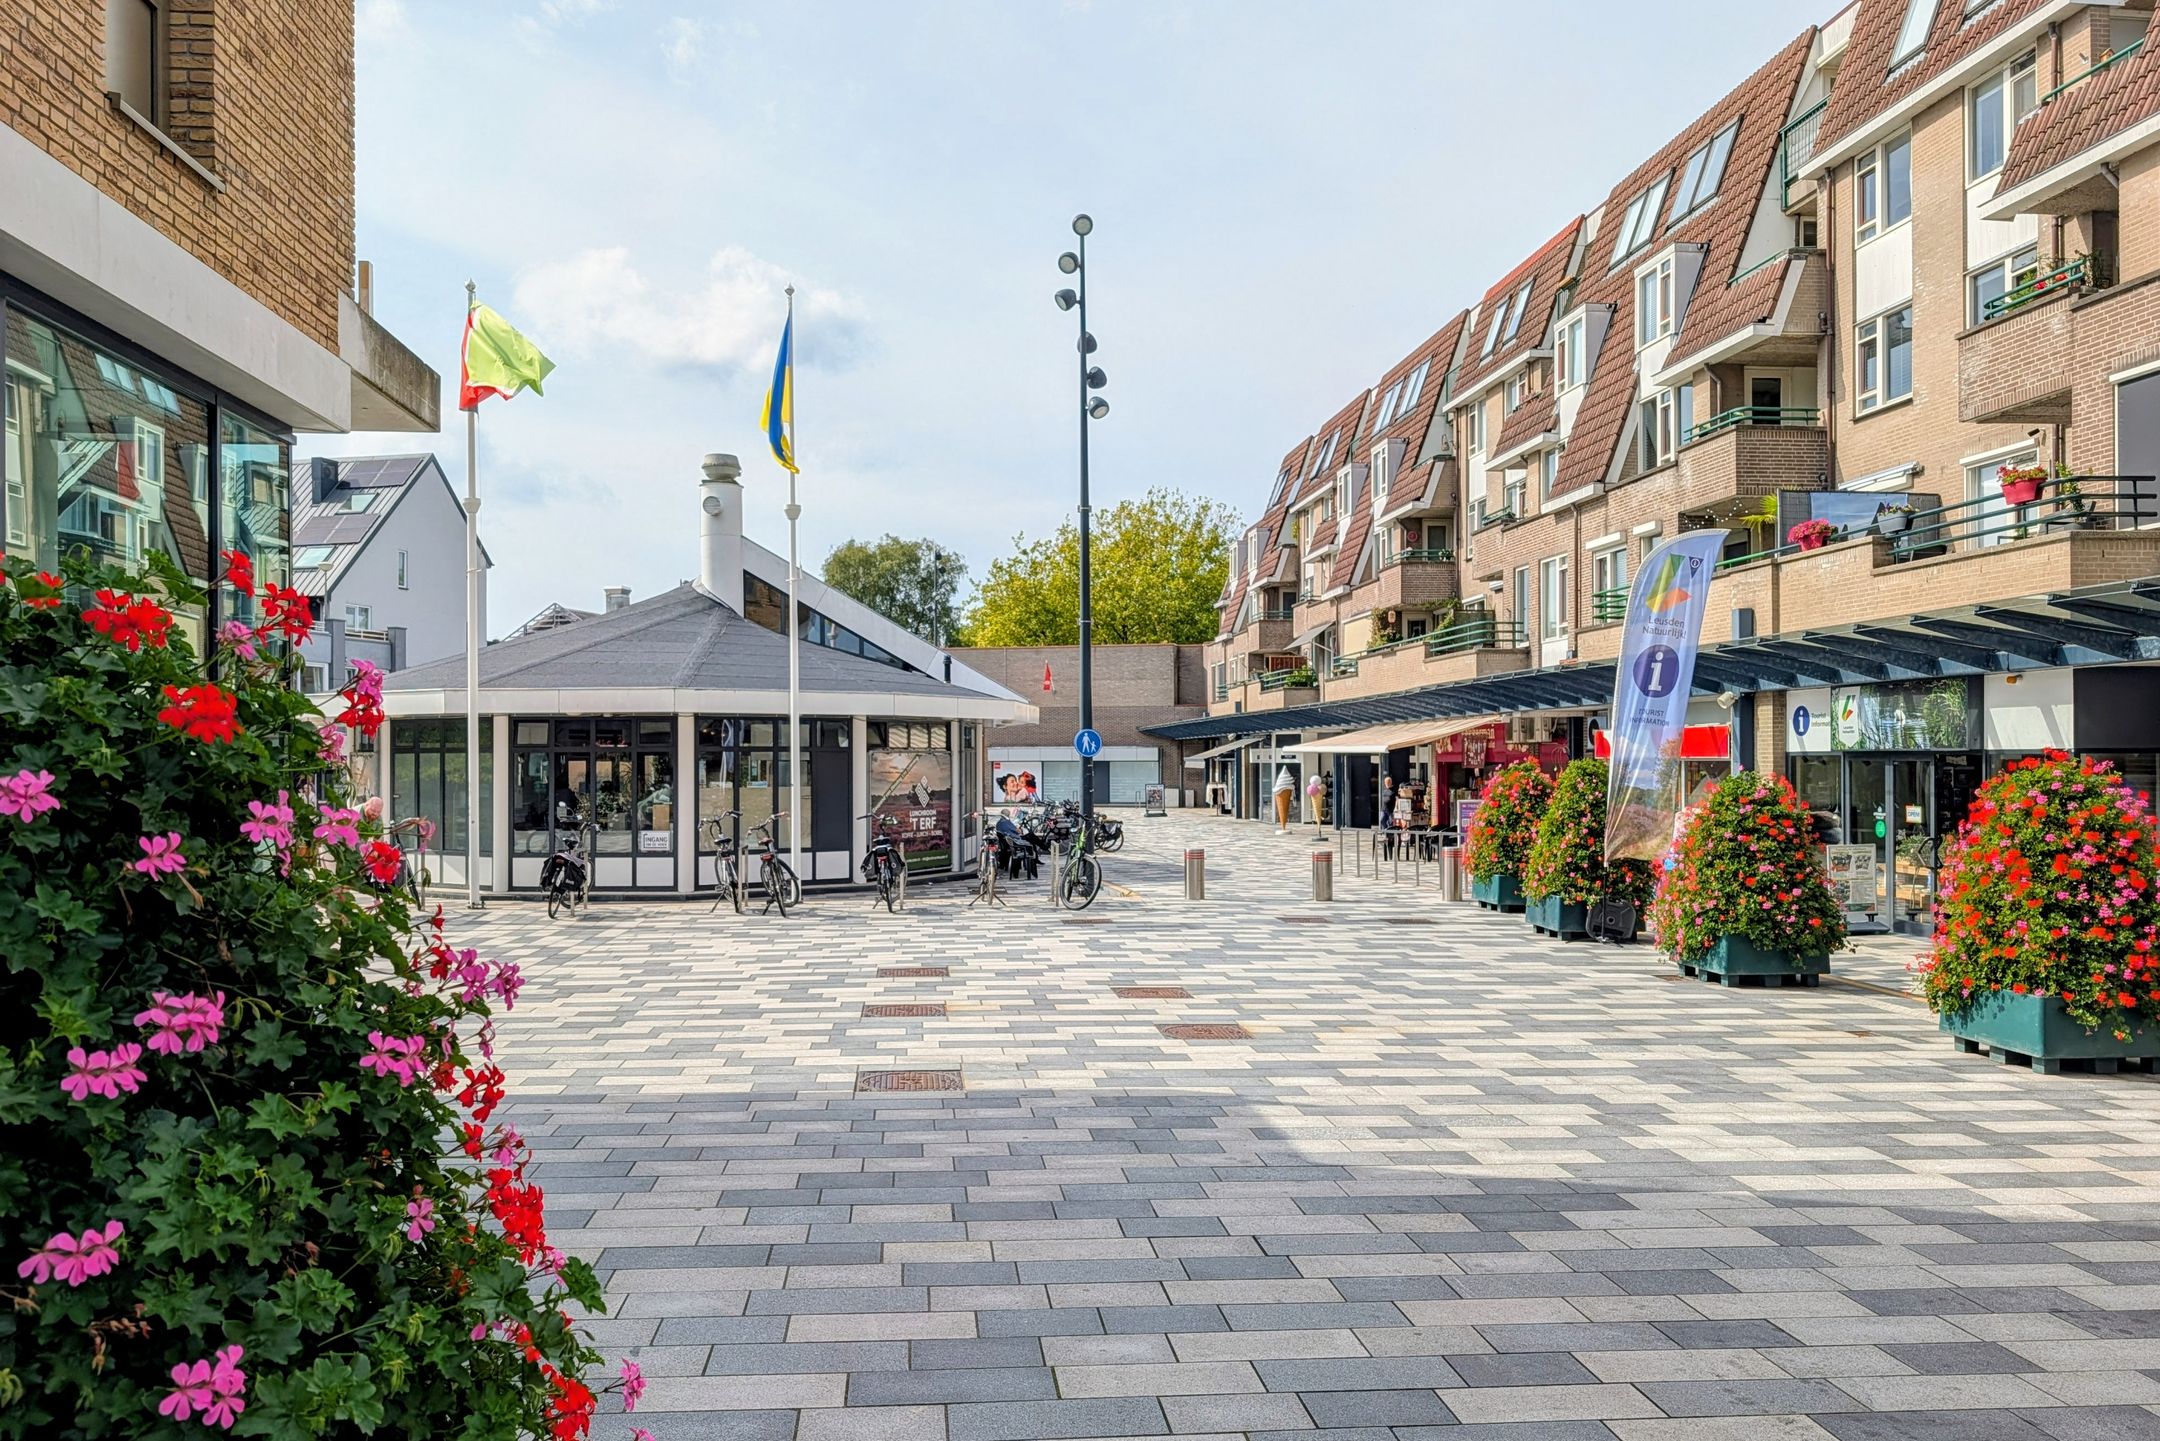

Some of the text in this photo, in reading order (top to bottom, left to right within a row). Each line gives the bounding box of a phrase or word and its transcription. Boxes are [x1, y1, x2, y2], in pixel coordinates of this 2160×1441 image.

[1648, 615, 1685, 628] Leusden
[1642, 626, 1687, 639] Natuurlijk!
[1648, 651, 1664, 691] i
[1639, 708, 1665, 717] TOURIST
[919, 817, 937, 830] ERF
